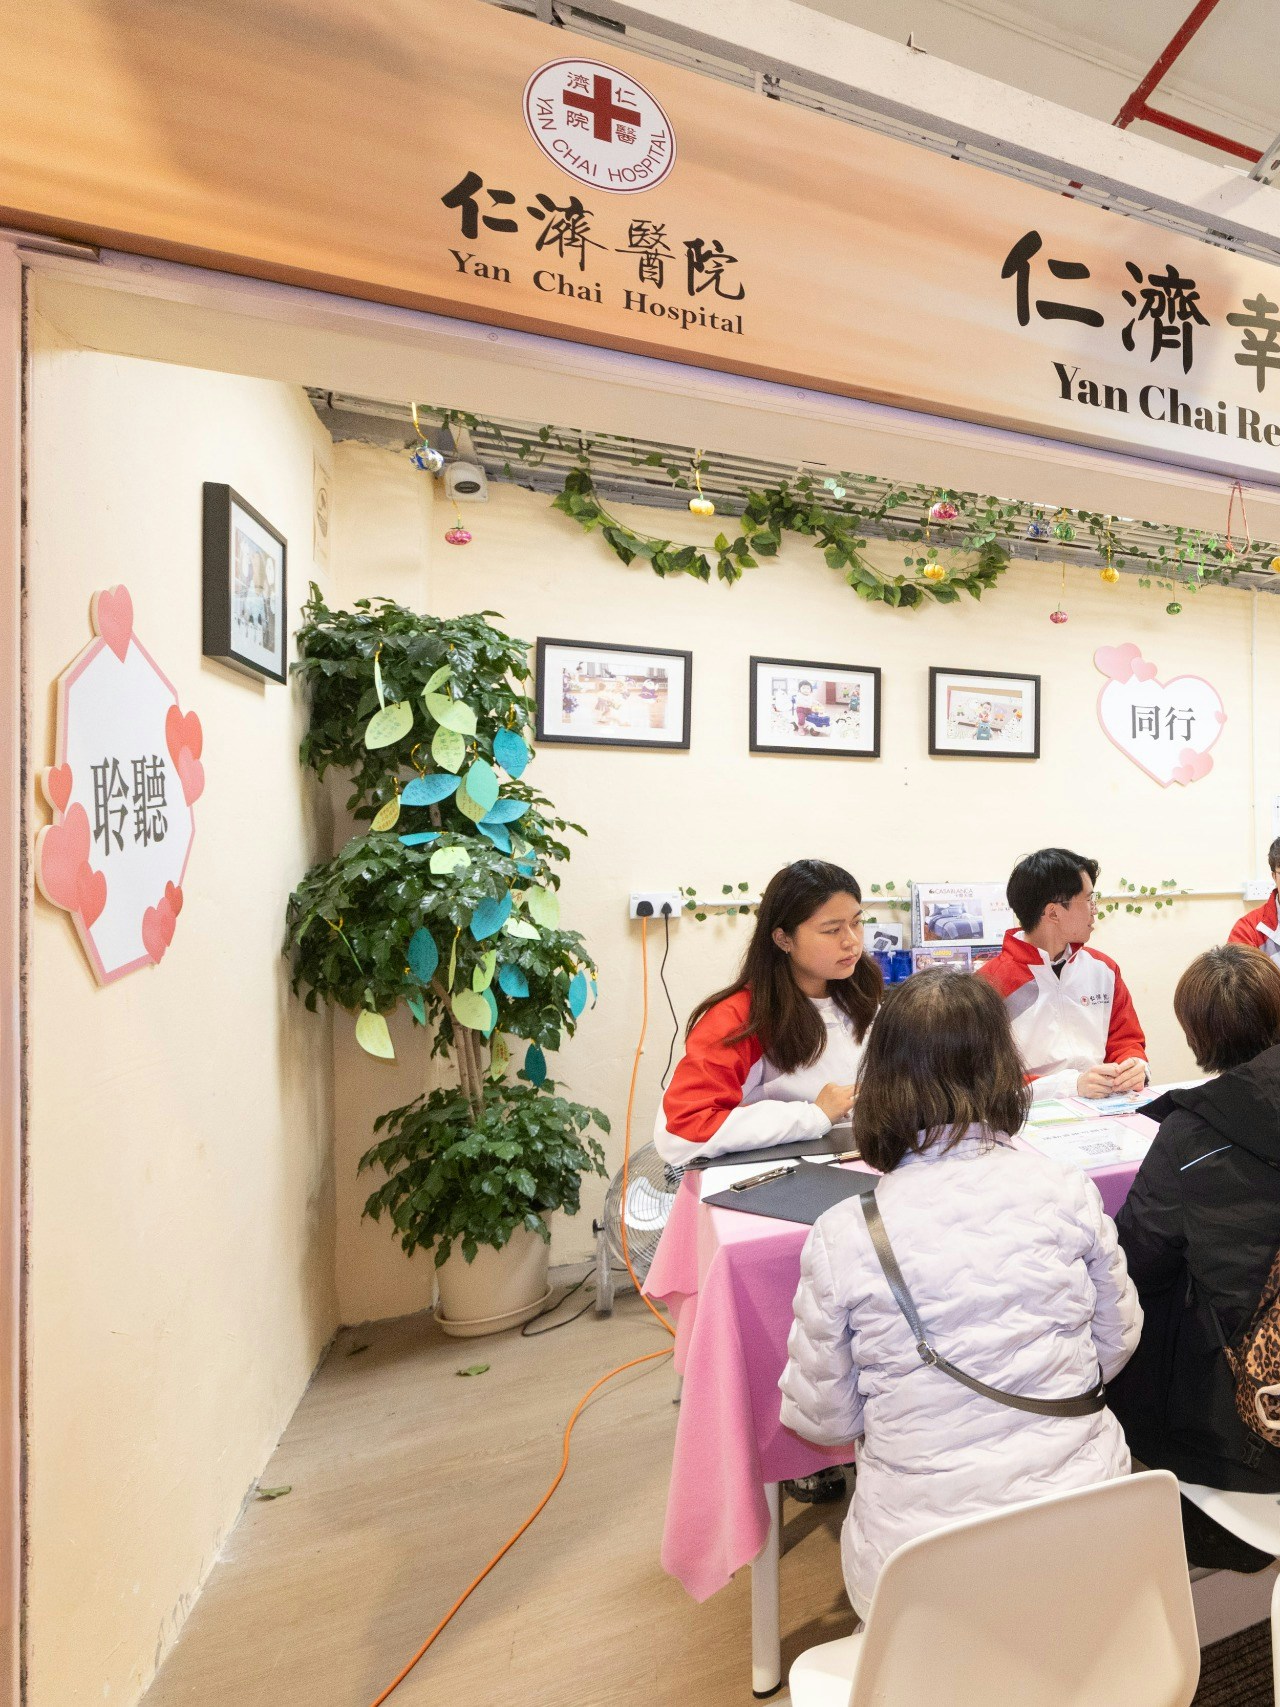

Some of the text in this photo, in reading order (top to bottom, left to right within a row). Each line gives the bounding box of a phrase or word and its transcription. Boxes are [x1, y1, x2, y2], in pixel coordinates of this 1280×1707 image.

[536, 97, 666, 183] YAN CHAI HOSPITAL
[441, 171, 745, 301] 仁濟醫院
[448, 249, 744, 335] Yan Chai Hospital
[1051, 360, 1129, 414] Yan
[1139, 384, 1226, 435] Chai
[1131, 704, 1196, 741] 同行
[90, 755, 168, 856] 聆聽
